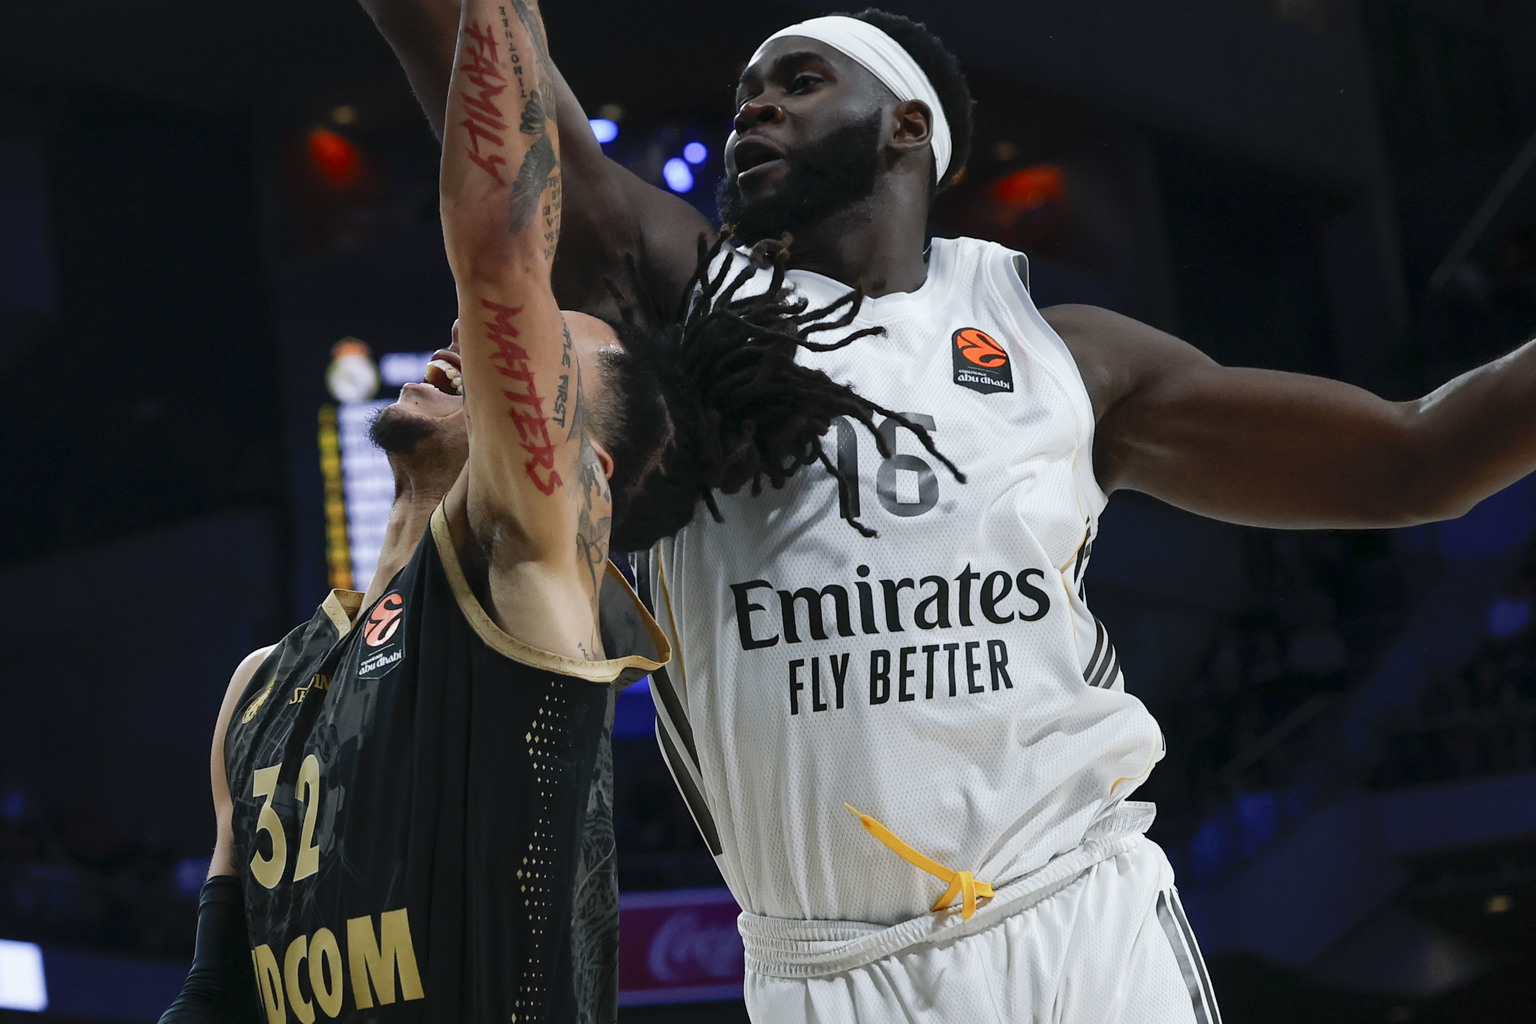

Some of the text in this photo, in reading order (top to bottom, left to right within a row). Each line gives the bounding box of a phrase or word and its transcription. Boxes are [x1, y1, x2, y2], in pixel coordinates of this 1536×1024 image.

[460, 19, 509, 188] FAMILY
[481, 299, 563, 497] MATTERS
[550, 374, 569, 429] FIRST
[957, 374, 1011, 390] abu dhabi
[830, 412, 940, 519] 16
[730, 562, 1051, 652] Emirates
[789, 639, 1014, 716] FLY BETTER
[250, 754, 320, 889] 32
[251, 907, 425, 1024] DCOM
